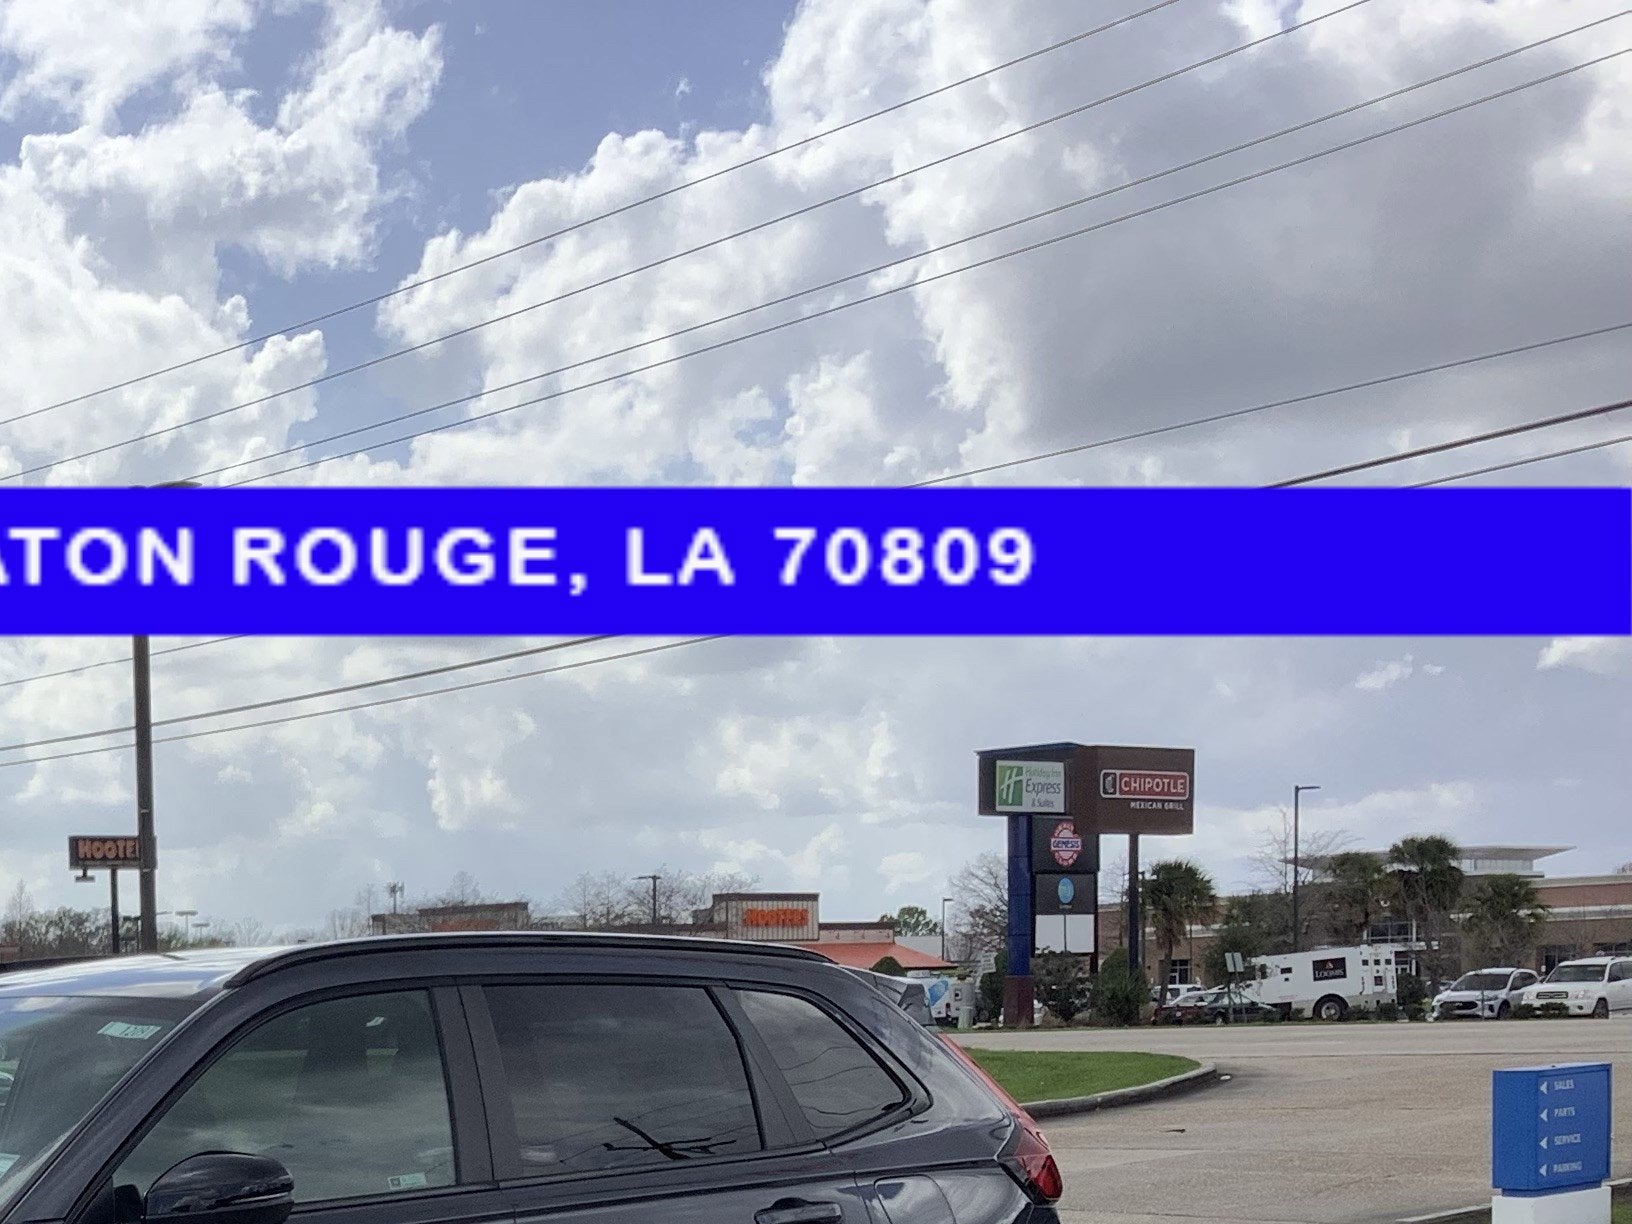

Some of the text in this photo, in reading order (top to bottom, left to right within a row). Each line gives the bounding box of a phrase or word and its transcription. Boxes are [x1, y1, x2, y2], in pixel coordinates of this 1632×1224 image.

[1025, 777, 1061, 797] Express
[1120, 776, 1185, 793] CHIPOTLE
[1129, 801, 1184, 811] MEXICAN GRILL
[77, 839, 139, 859] HOOTE
[1052, 840, 1081, 849] GENESIS
[1554, 1079, 1575, 1090] SALES
[1554, 1106, 1576, 1117] PARTS
[1554, 1133, 1581, 1145] SERVICE
[1553, 1161, 1582, 1173] PARKING
